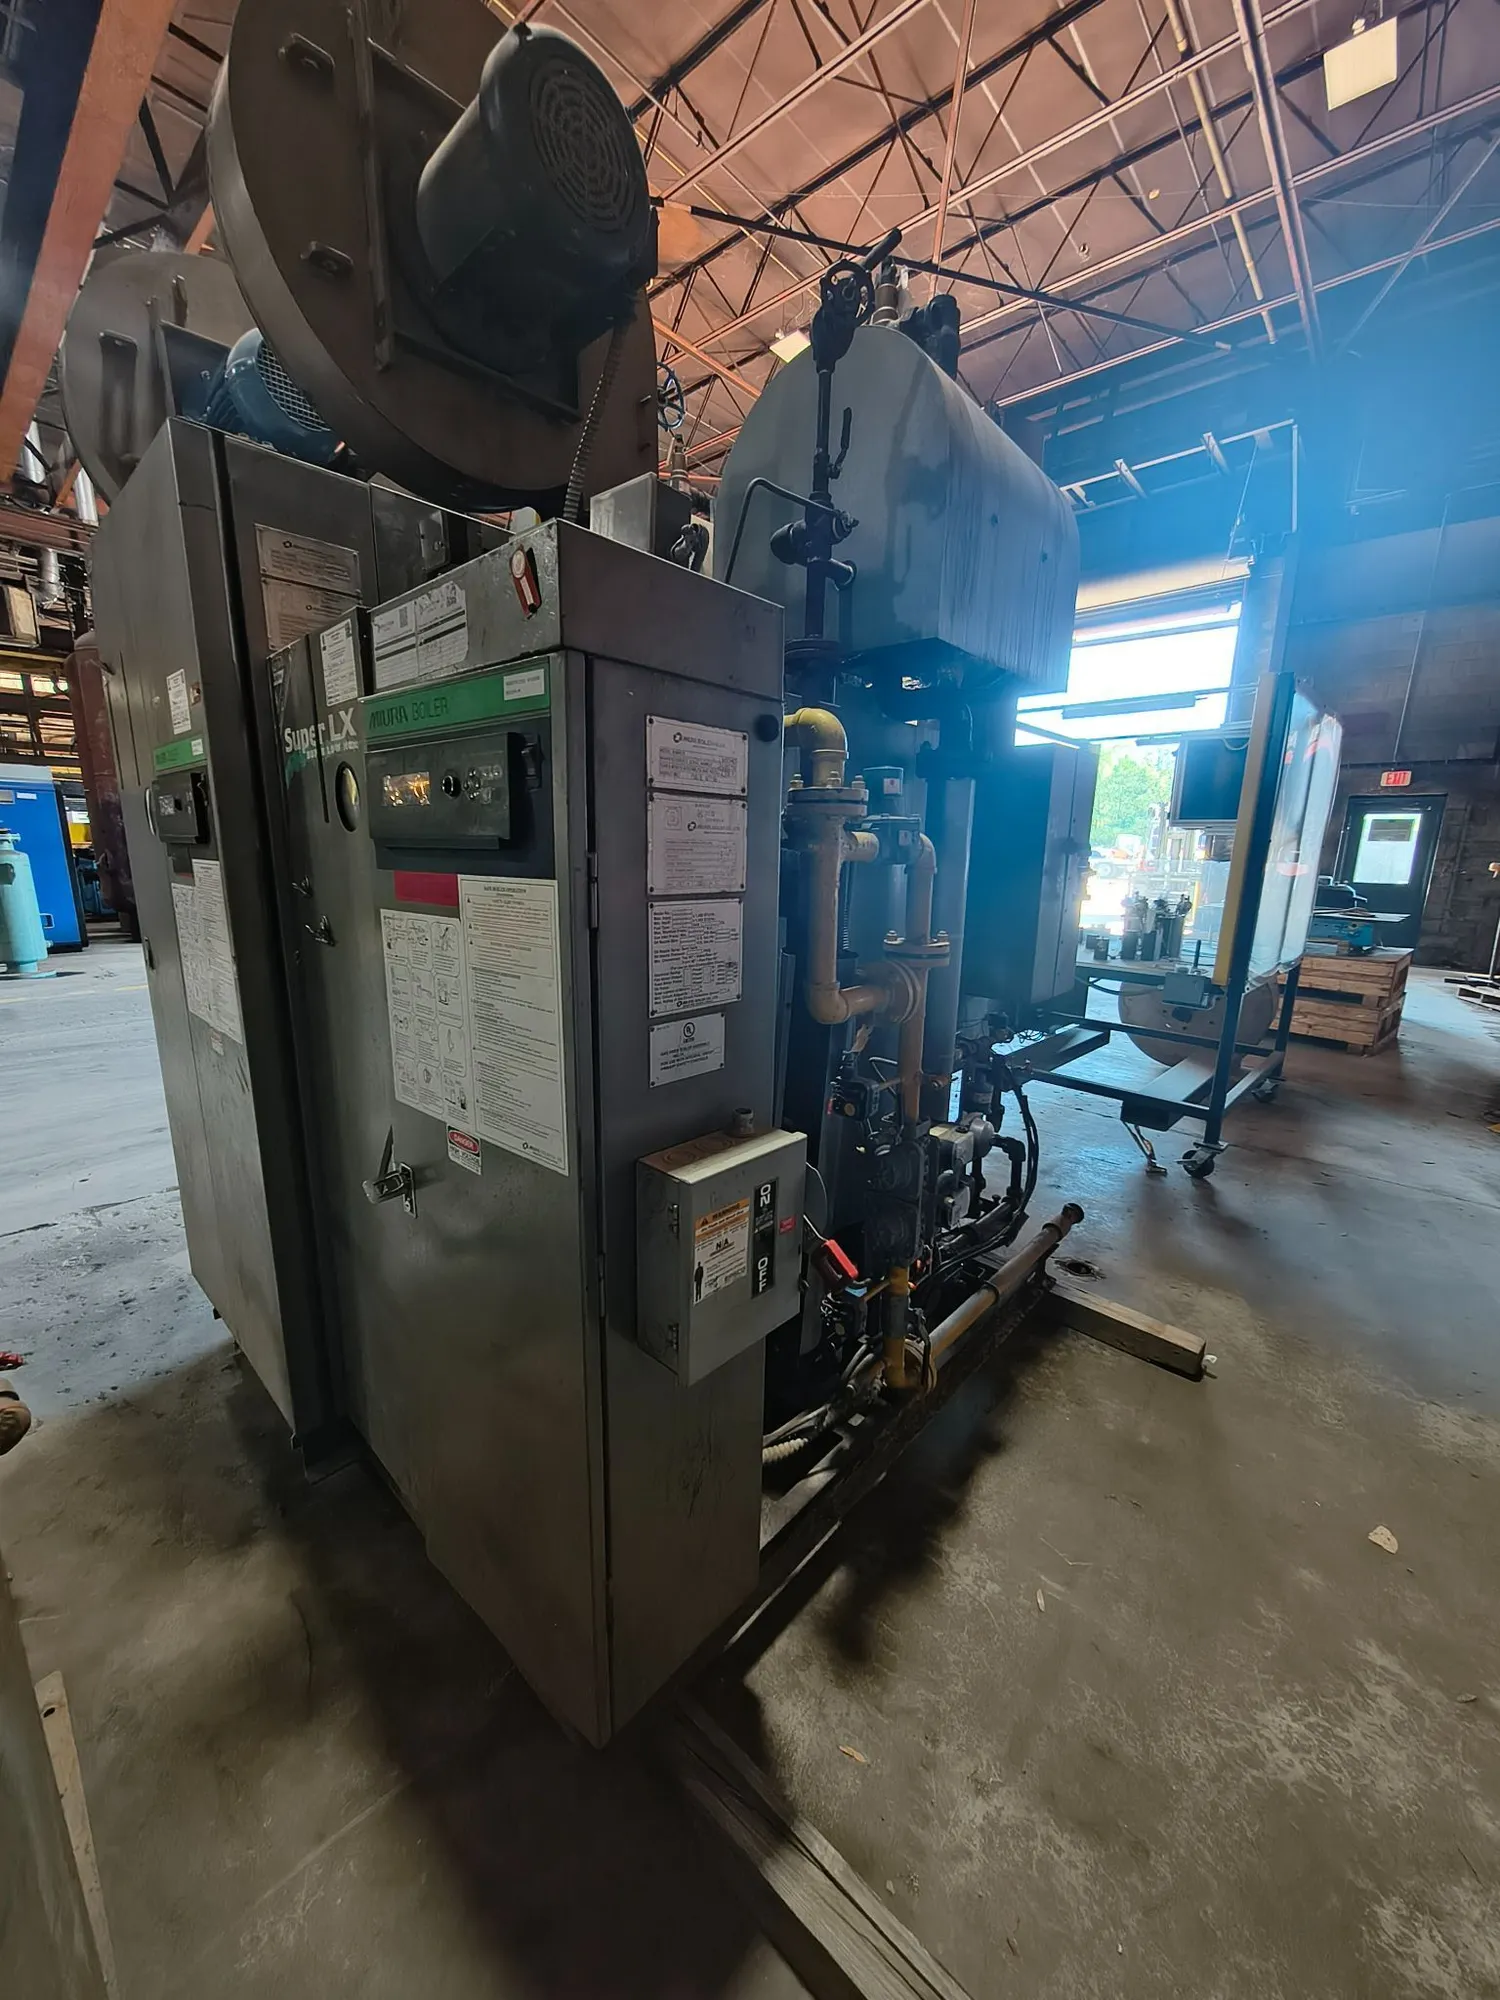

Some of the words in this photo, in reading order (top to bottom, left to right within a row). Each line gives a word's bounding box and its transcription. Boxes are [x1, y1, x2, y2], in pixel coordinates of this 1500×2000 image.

[284, 722, 327, 754] Super
[327, 706, 357, 742] LX
[369, 705, 408, 730] MIURA
[411, 697, 449, 721] BOILER
[1385, 772, 1410, 785] EXIT
[759, 1183, 772, 1208] ON
[757, 1256, 769, 1293] OFF
